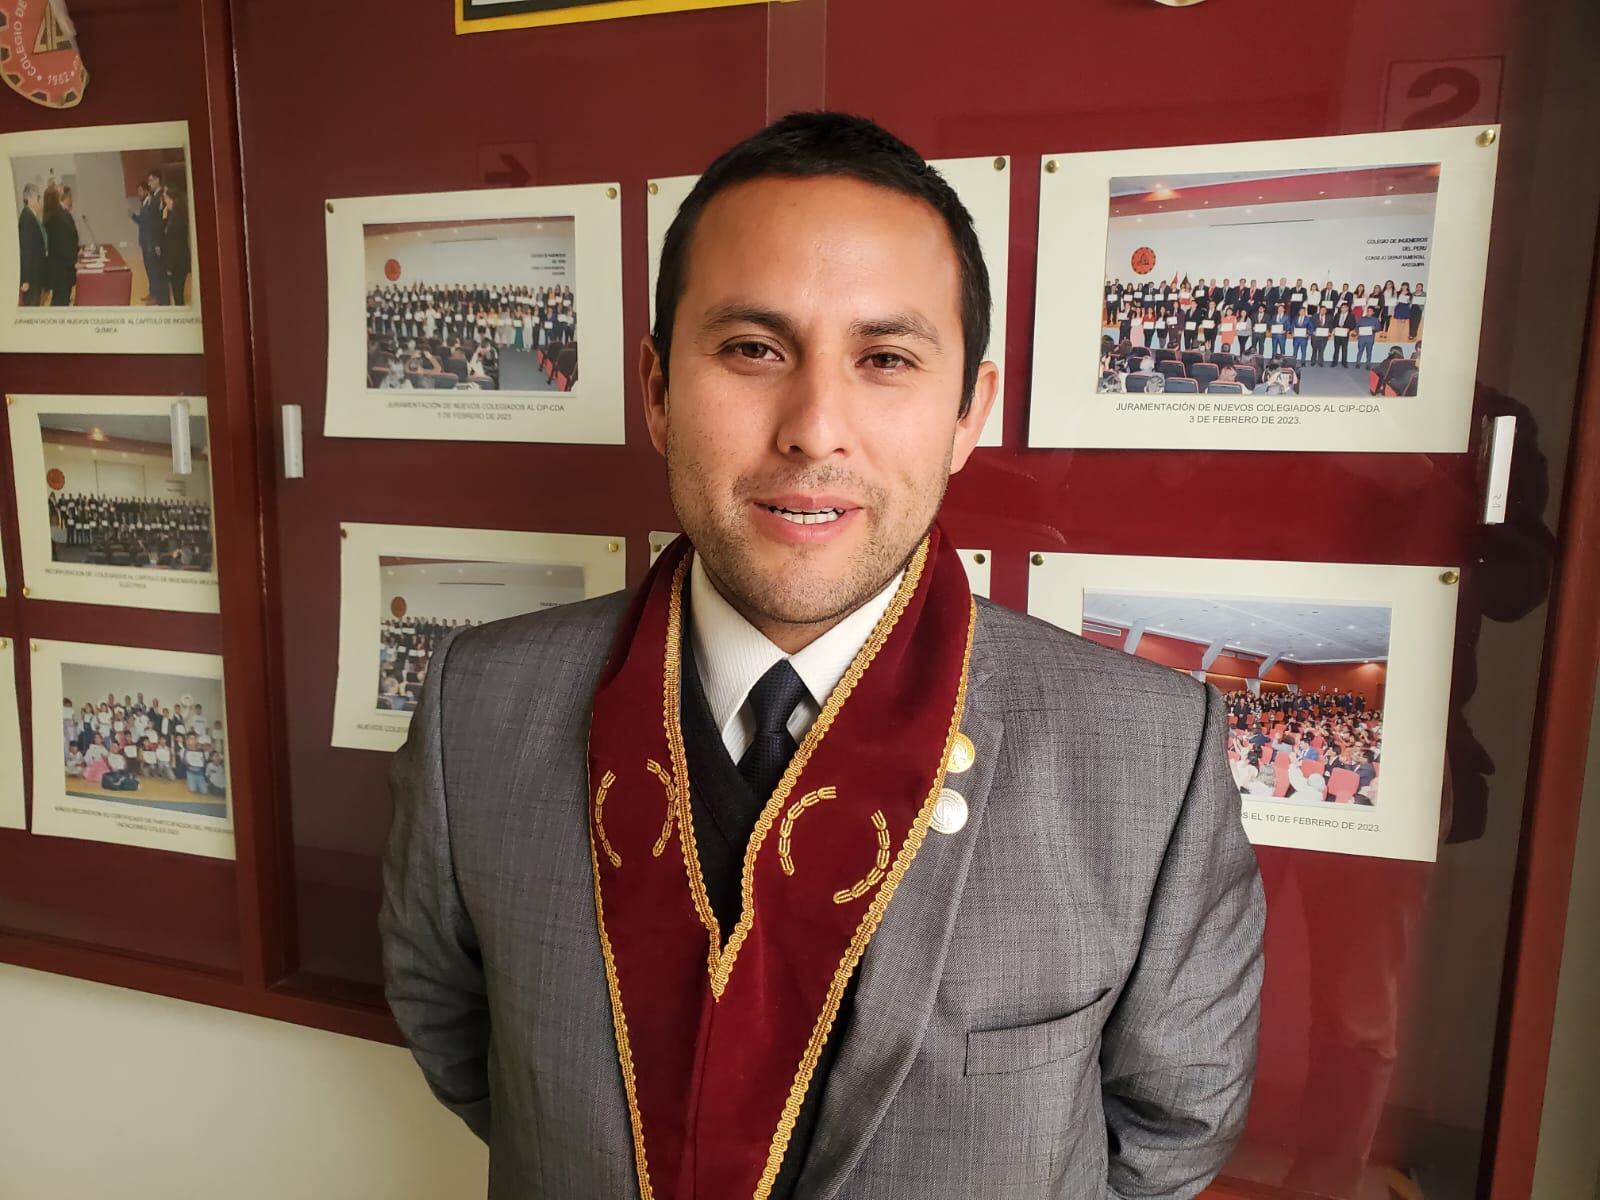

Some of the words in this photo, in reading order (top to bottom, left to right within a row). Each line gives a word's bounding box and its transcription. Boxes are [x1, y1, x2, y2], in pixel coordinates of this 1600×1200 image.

[14, 20, 36, 76] COLEGIO
[1115, 402, 1196, 412] JURAMENTACIÓN
[1198, 403, 1211, 412] DE
[1213, 403, 1254, 413] NUEVOS
[1256, 403, 1321, 413] COLEGIADOS
[1323, 404, 1336, 414] AL
[1338, 404, 1381, 414] CIP-CDA
[1189, 415, 1195, 424] 3
[1197, 415, 1211, 424] DE
[1212, 415, 1259, 425] FEBRERO
[1261, 415, 1275, 425] DE
[1277, 416, 1302, 425] 2023.
[1250, 812, 1263, 821] EL
[1265, 814, 1276, 823] 10
[1277, 815, 1292, 824] DE
[1293, 816, 1339, 829] FEBRERO
[1341, 821, 1354, 831] DE
